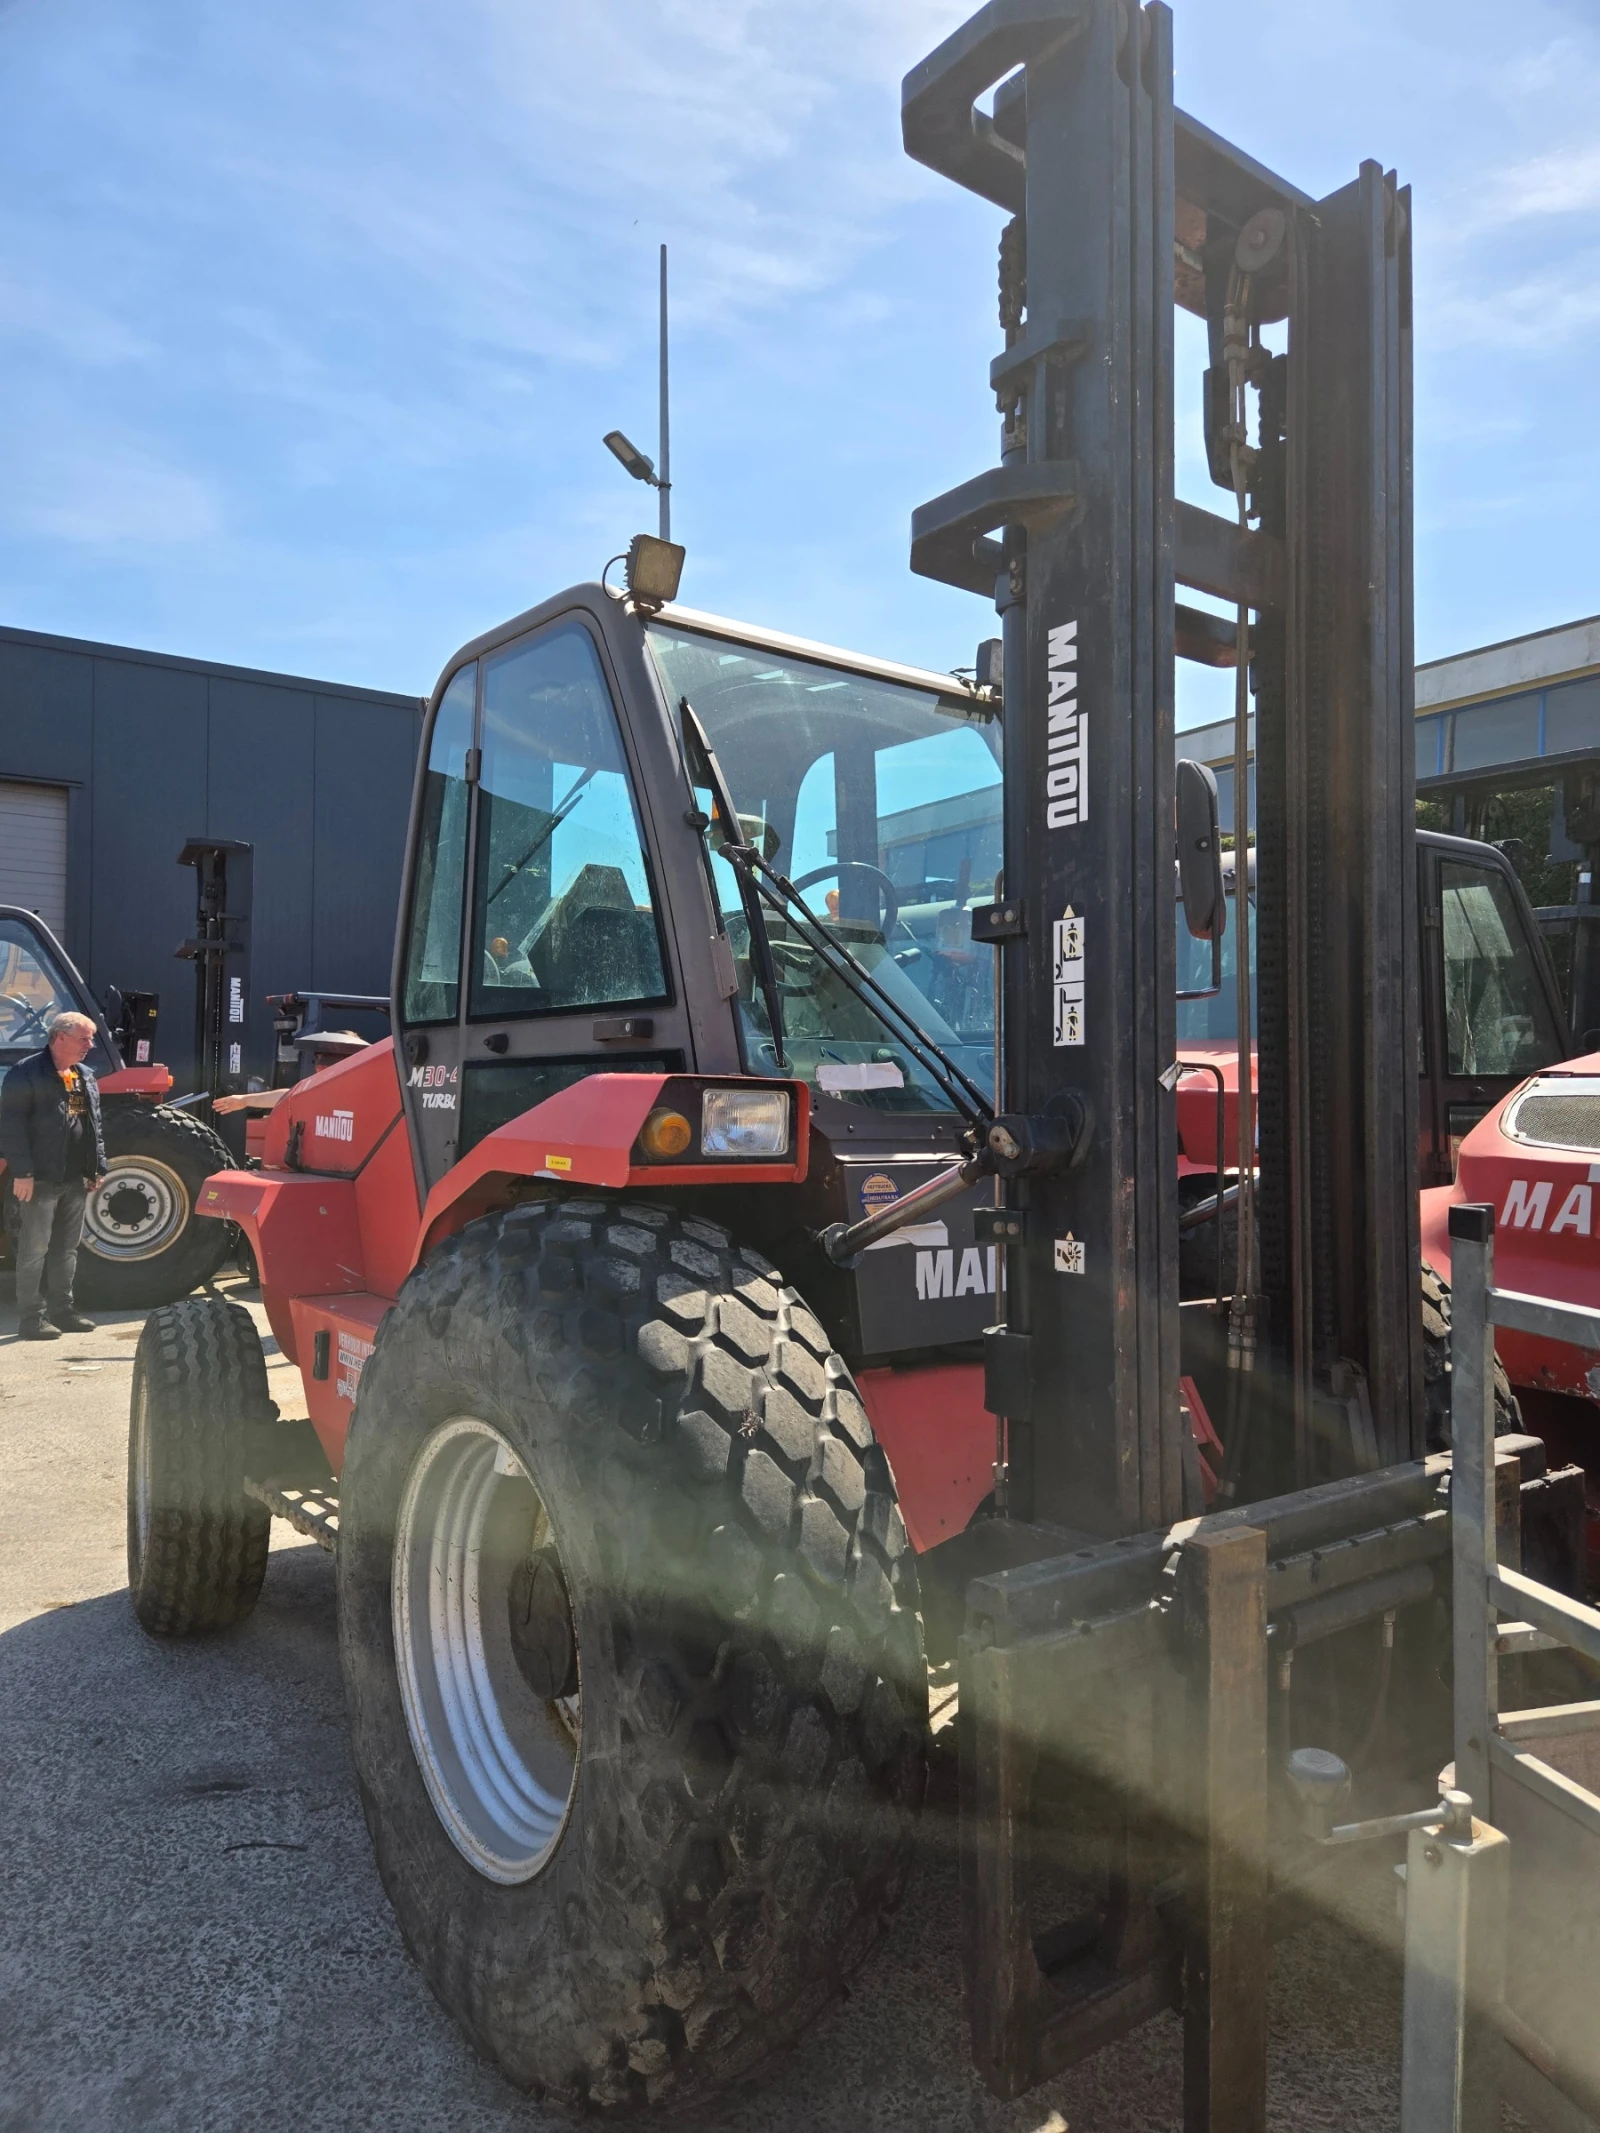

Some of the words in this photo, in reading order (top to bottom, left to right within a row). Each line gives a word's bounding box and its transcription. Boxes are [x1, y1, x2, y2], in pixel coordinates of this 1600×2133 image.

[1047, 620, 1088, 829] MANITOU
[229, 977, 244, 1023] MANITOU
[315, 1109, 354, 1142] MANITOU
